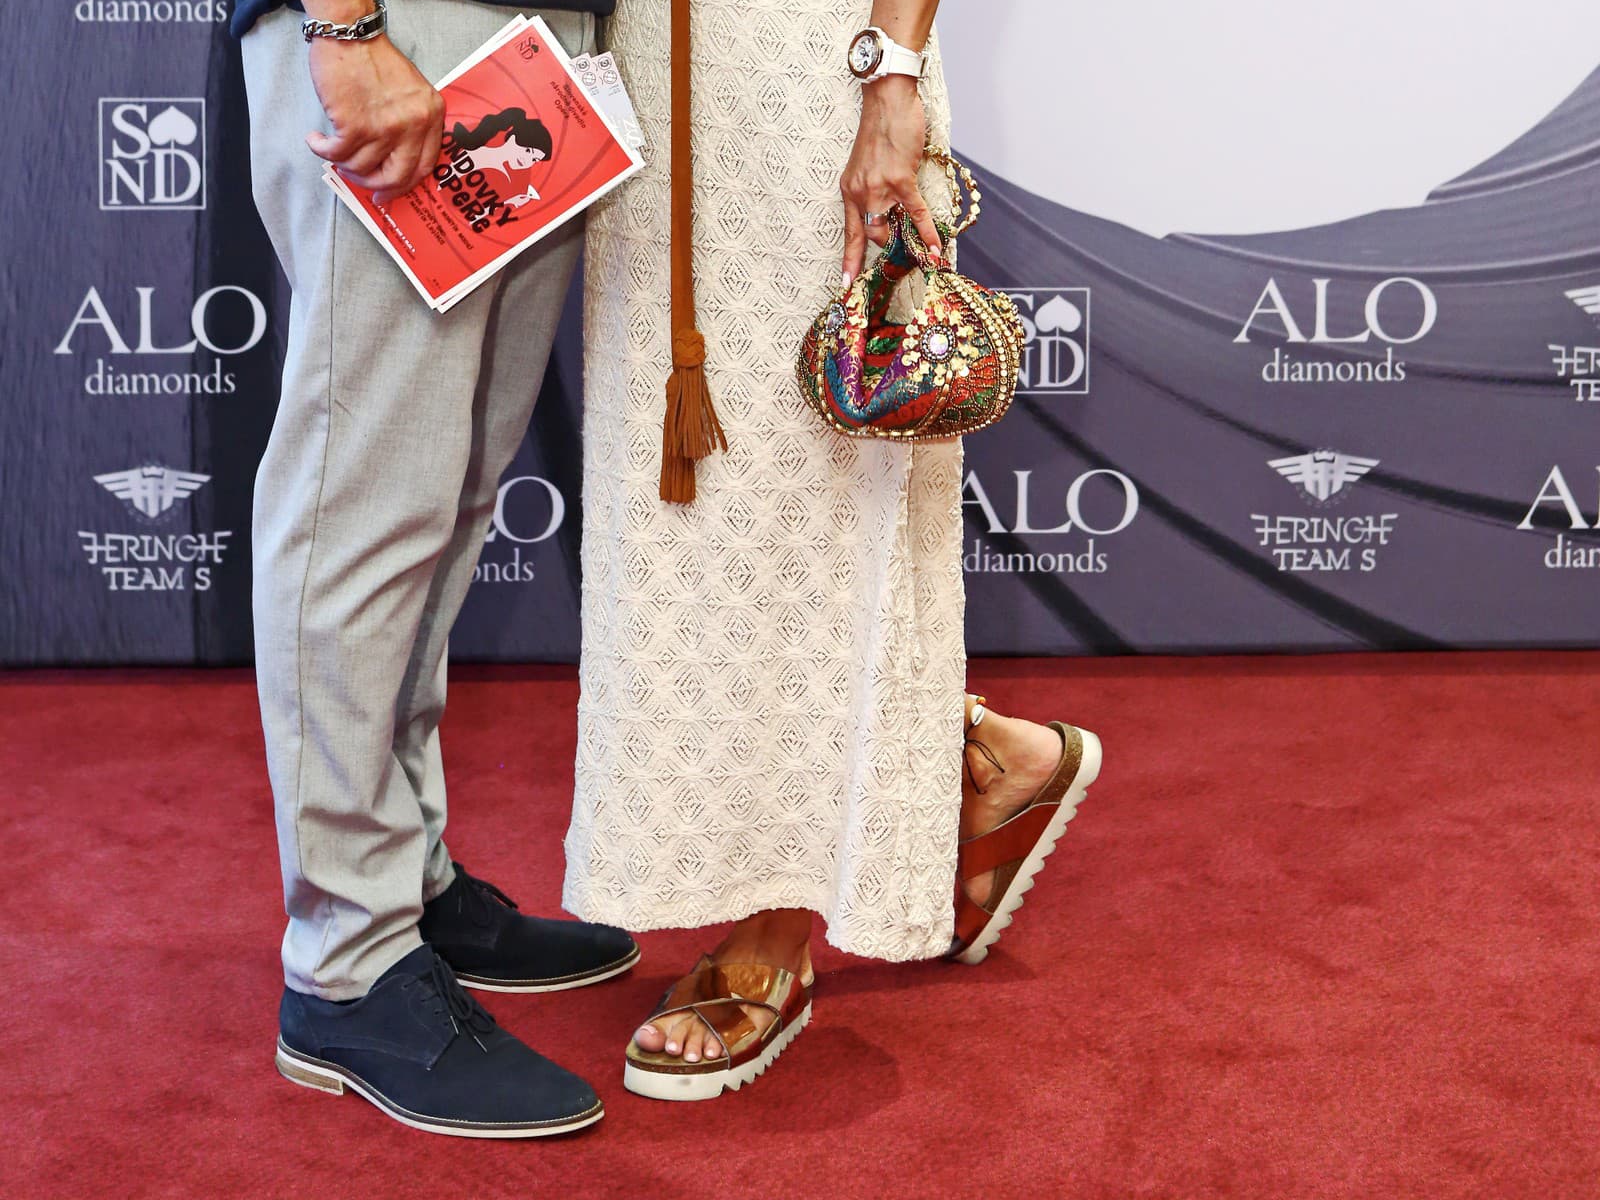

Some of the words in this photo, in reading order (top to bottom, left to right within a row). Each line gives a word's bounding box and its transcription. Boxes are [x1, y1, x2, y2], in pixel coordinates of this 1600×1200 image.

[442, 131, 519, 227] ONDOVKY
[54, 285, 267, 354] ALO
[1232, 276, 1438, 345] ALO
[85, 359, 236, 395] diamonds
[1262, 344, 1406, 383] diamonds
[962, 469, 1139, 535] ALO
[964, 538, 1108, 573] diamonds
[1273, 548, 1351, 572] TEAM
[1360, 550, 1376, 572] S
[102, 567, 185, 591] TEAM
[194, 567, 212, 591] S
